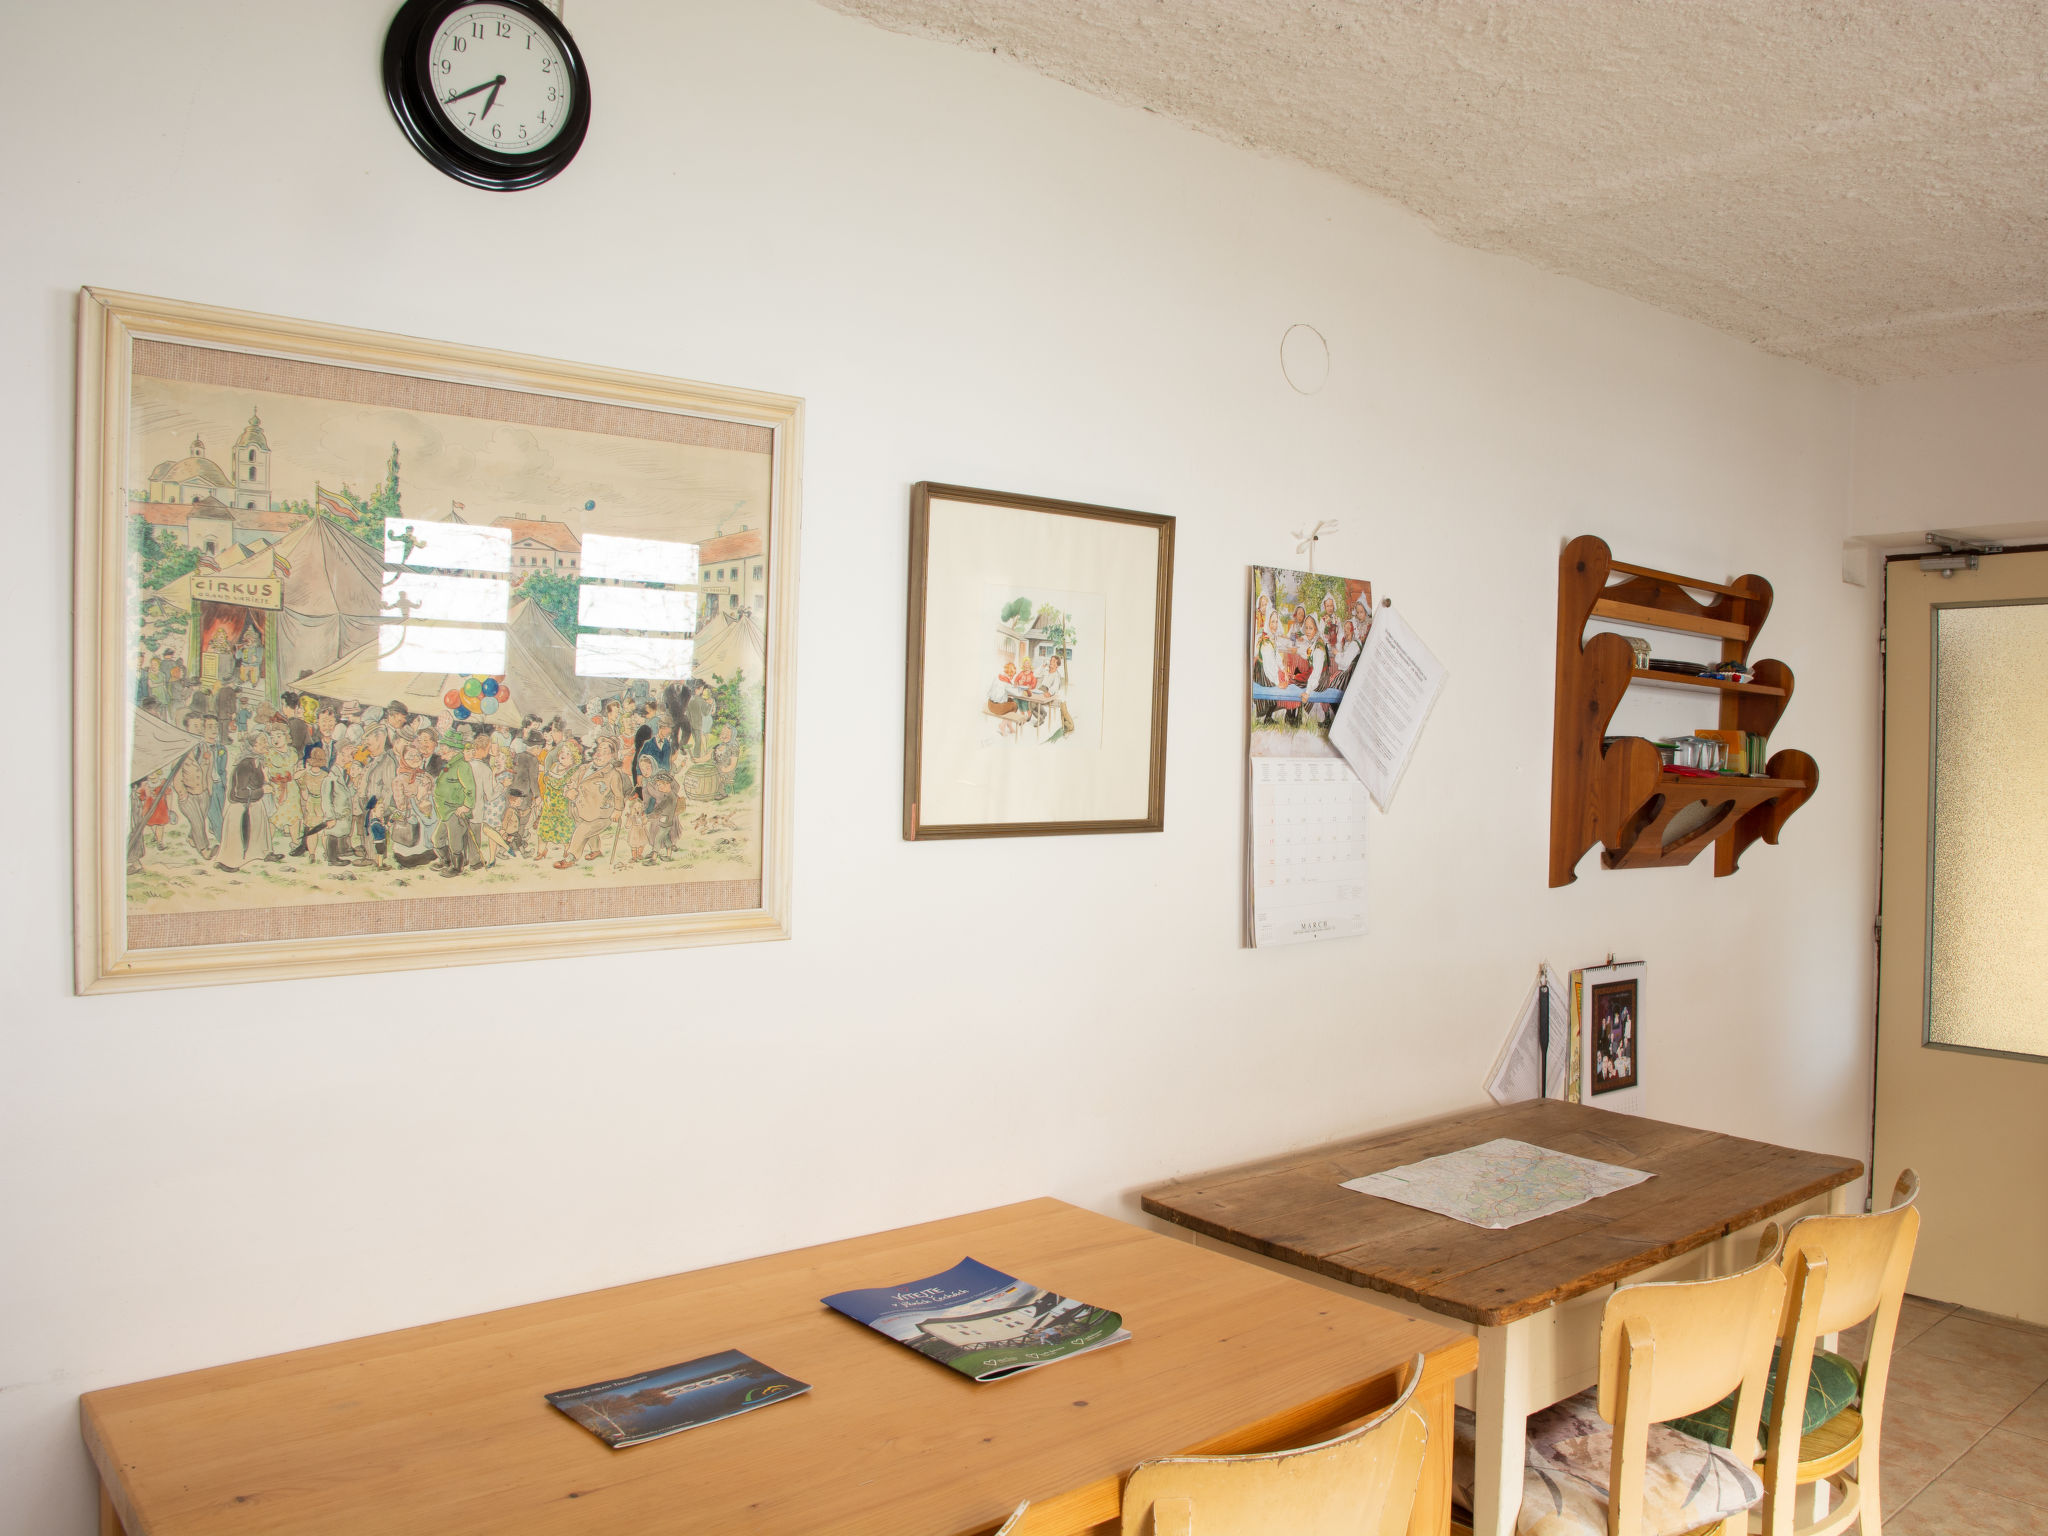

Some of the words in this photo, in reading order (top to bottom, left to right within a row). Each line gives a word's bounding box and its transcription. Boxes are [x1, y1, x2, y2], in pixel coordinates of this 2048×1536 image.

[471, 22, 485, 40] 11
[496, 21, 511, 38] 12
[452, 36, 467, 52] 10
[525, 35, 532, 50] 1
[441, 59, 452, 75] 9
[542, 58, 551, 73] 2
[448, 88, 458, 104] 8
[547, 87, 557, 102] 3
[467, 112, 477, 126] 7
[537, 110, 547, 124] 4
[492, 124, 502, 139] 6
[518, 125, 527, 139] 5
[1301, 921, 1328, 930] MARCH
